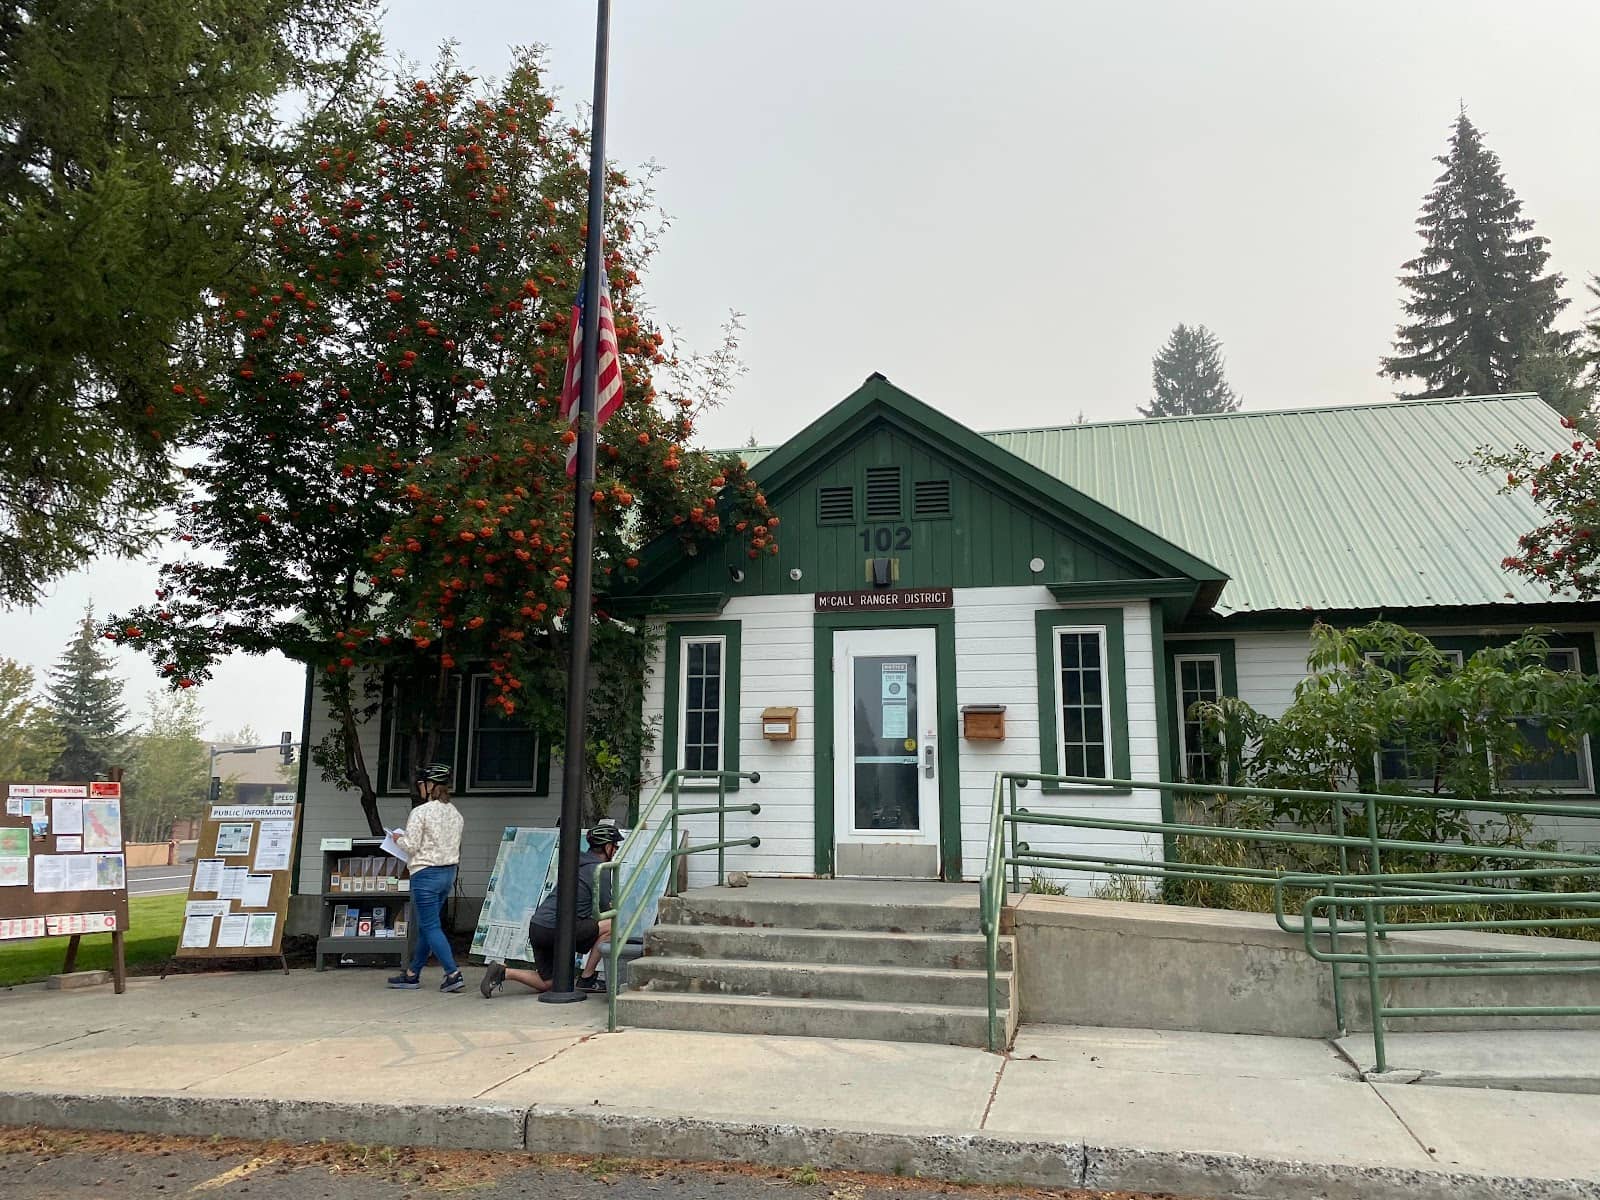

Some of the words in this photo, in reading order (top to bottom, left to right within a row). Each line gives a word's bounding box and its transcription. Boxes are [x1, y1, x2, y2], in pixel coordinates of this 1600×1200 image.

[859, 526, 912, 552] 102
[860, 593, 899, 606] RANGER
[904, 592, 947, 604] DISTRICT
